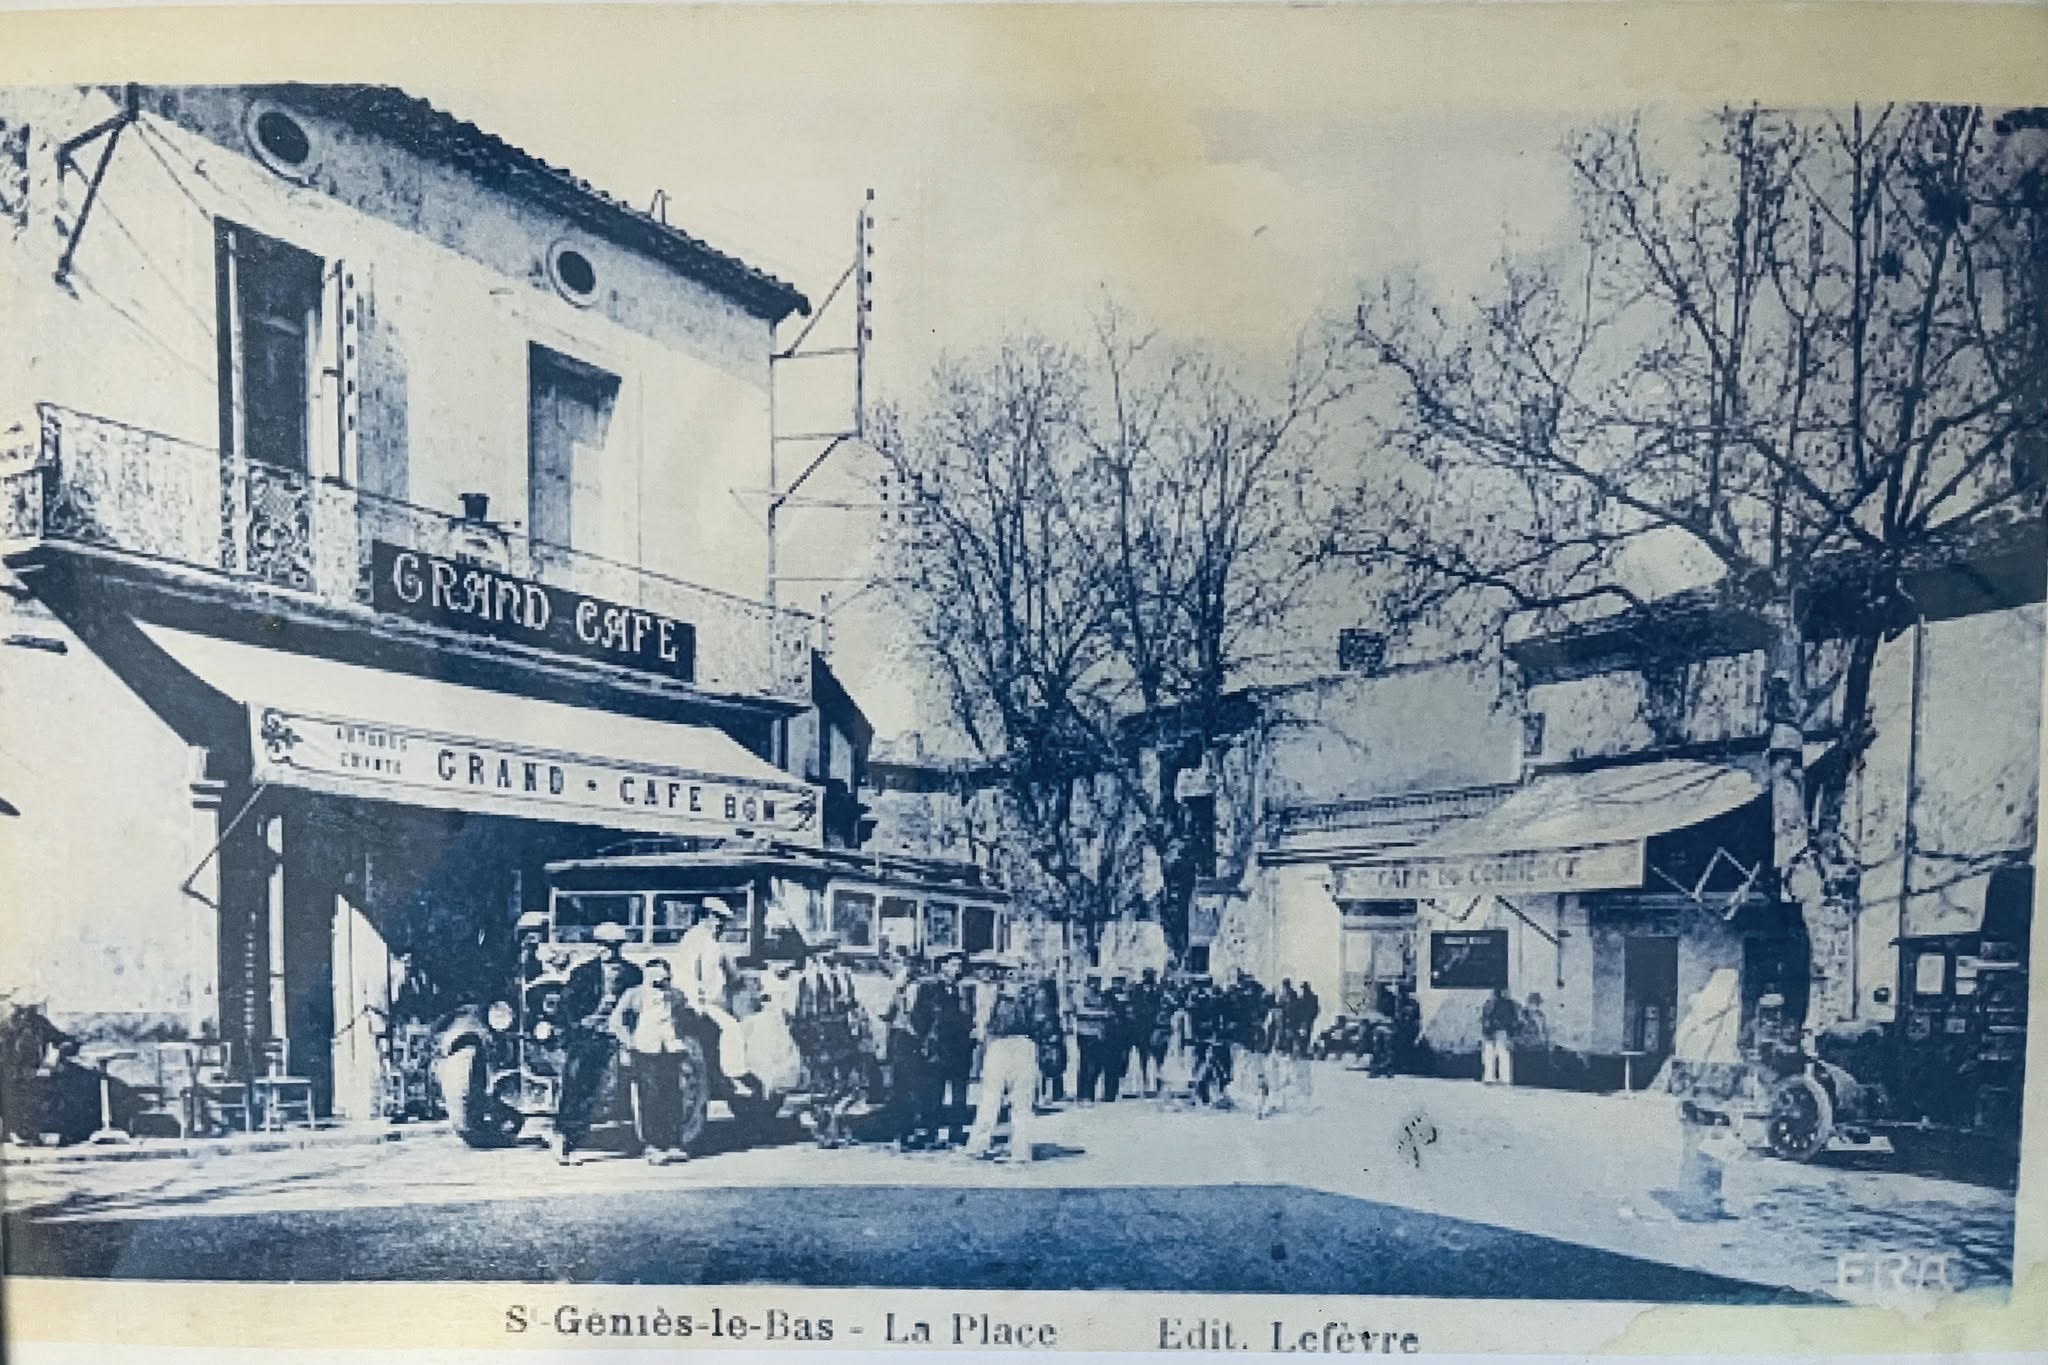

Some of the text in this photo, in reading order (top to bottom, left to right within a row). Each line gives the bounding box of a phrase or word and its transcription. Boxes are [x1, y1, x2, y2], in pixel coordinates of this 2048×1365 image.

[393, 552, 678, 662] GRAND CAFE
[438, 748, 564, 794] GRAND
[620, 776, 702, 812] CAFE
[884, 1312, 932, 1344] La
[952, 1312, 1057, 1347] Place
[1159, 1317, 1248, 1350] Edit.
